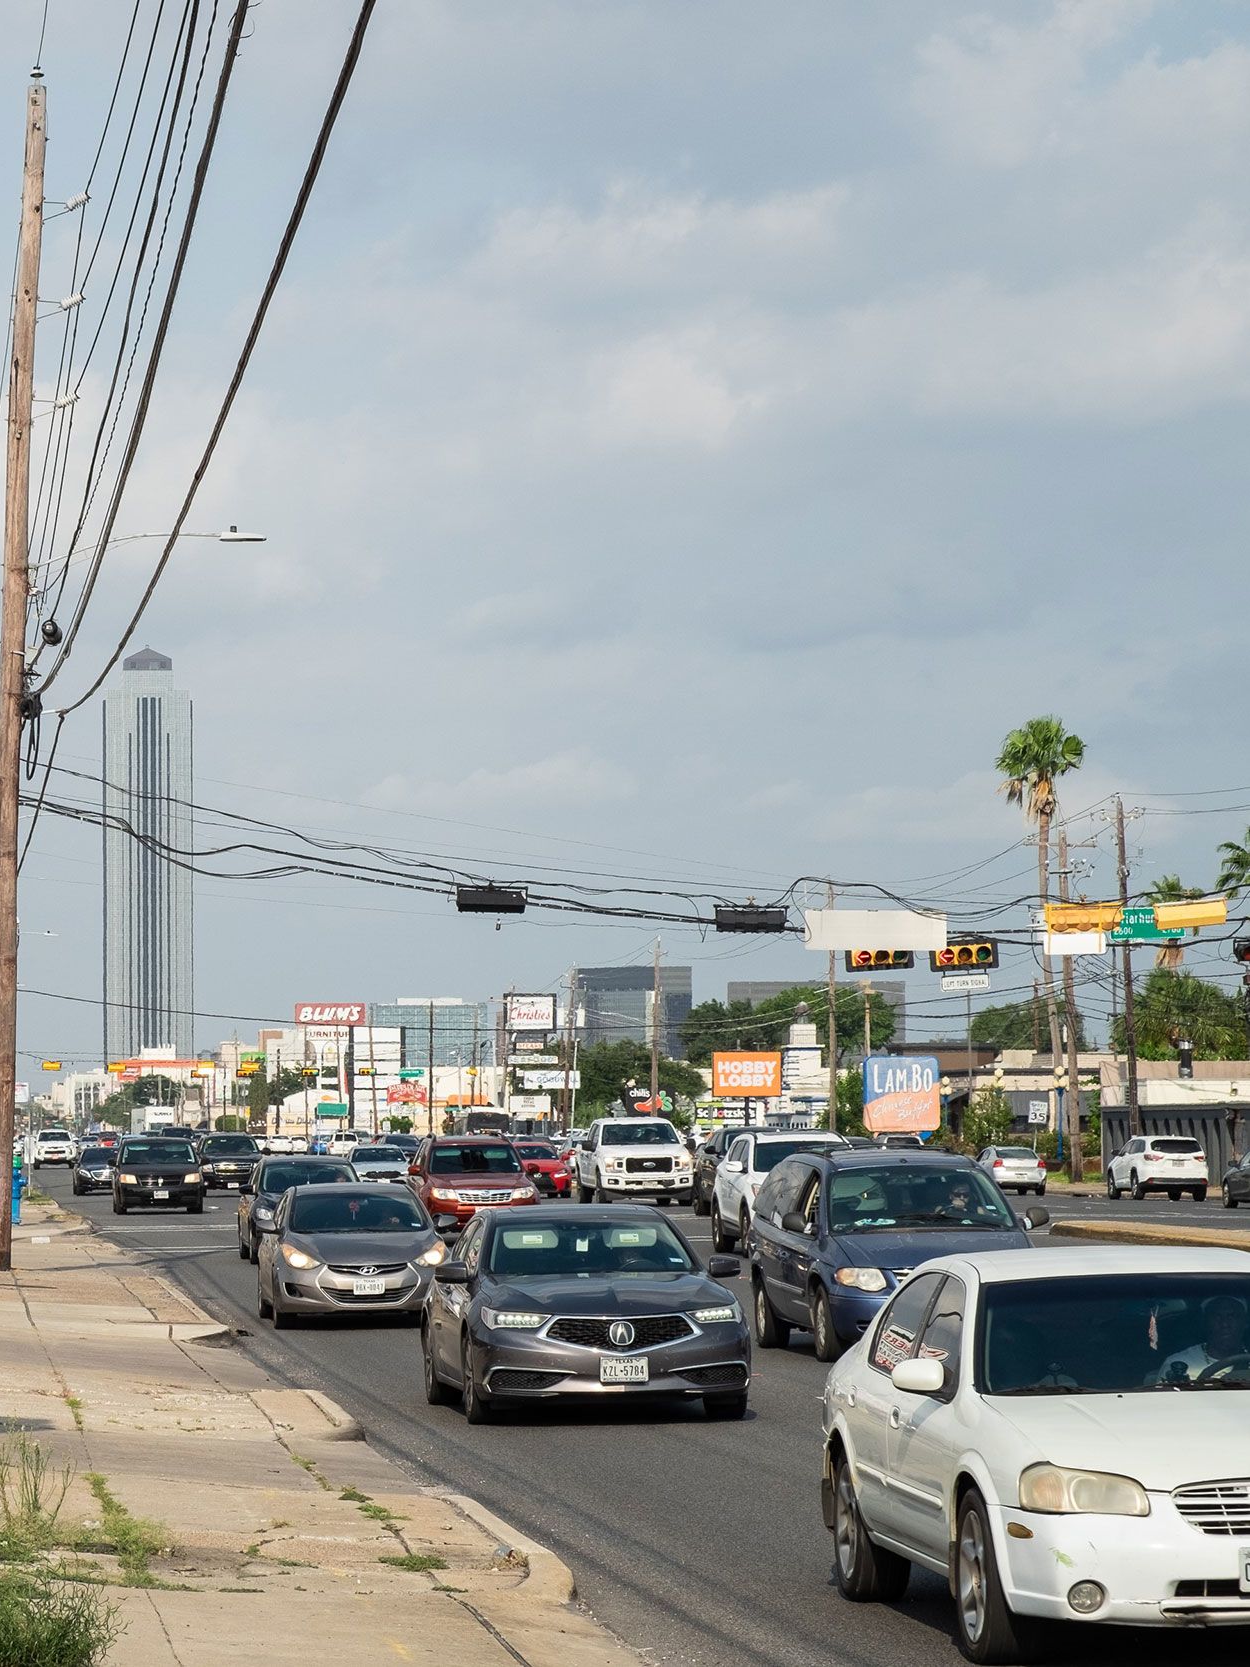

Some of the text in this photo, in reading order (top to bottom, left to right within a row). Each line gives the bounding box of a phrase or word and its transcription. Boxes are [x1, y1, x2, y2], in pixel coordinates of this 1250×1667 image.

[299, 1005, 361, 1022] BLUM'S
[717, 1061, 777, 1074] HOBBY
[719, 1074, 775, 1087] LOBBY
[1031, 1112, 1045, 1121] 35
